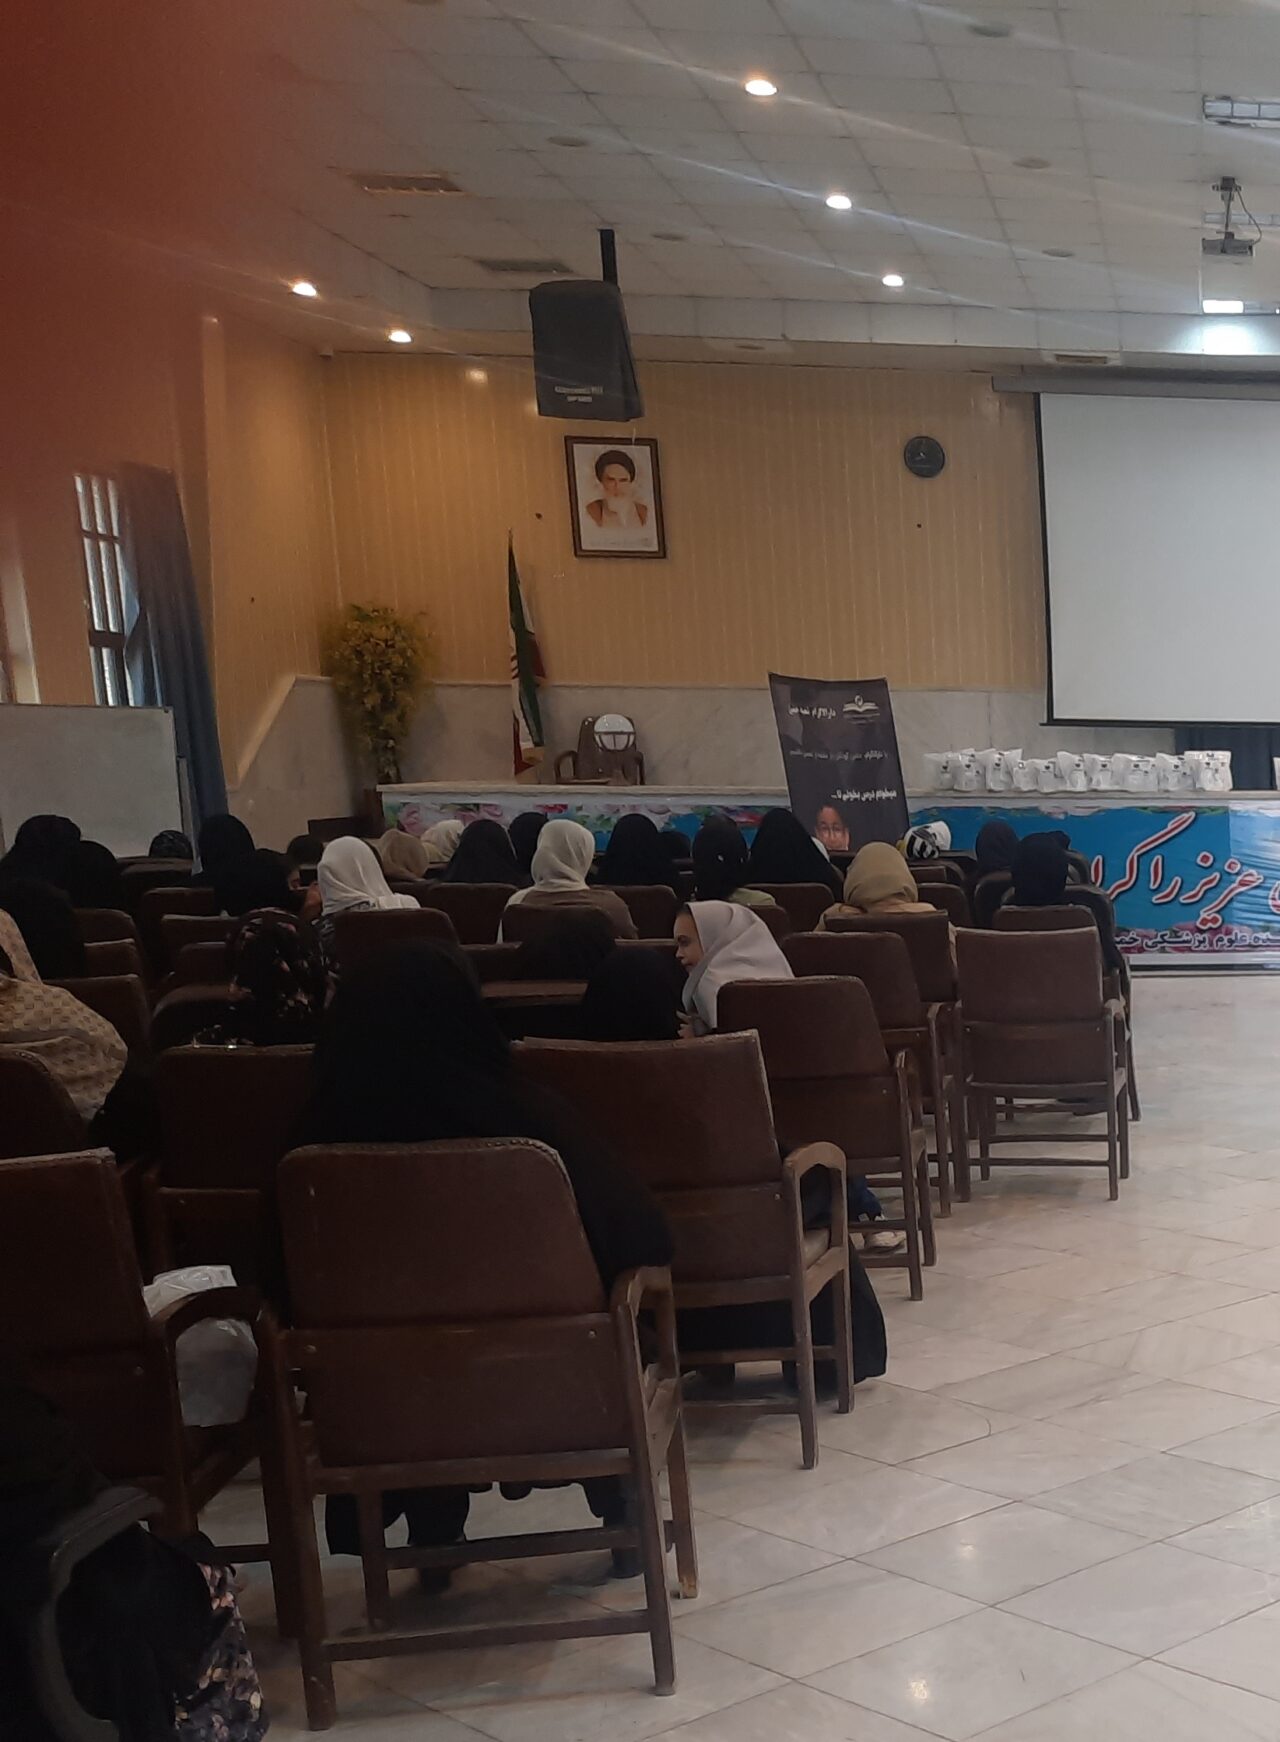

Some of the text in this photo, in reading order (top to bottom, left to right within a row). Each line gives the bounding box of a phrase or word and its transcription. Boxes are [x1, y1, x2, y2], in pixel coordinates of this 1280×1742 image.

[1151, 855, 1182, 904] را
[1179, 851, 1264, 930] عزیز
[1145, 929, 1209, 950] پزشکی
[1214, 929, 1249, 949] علوم
